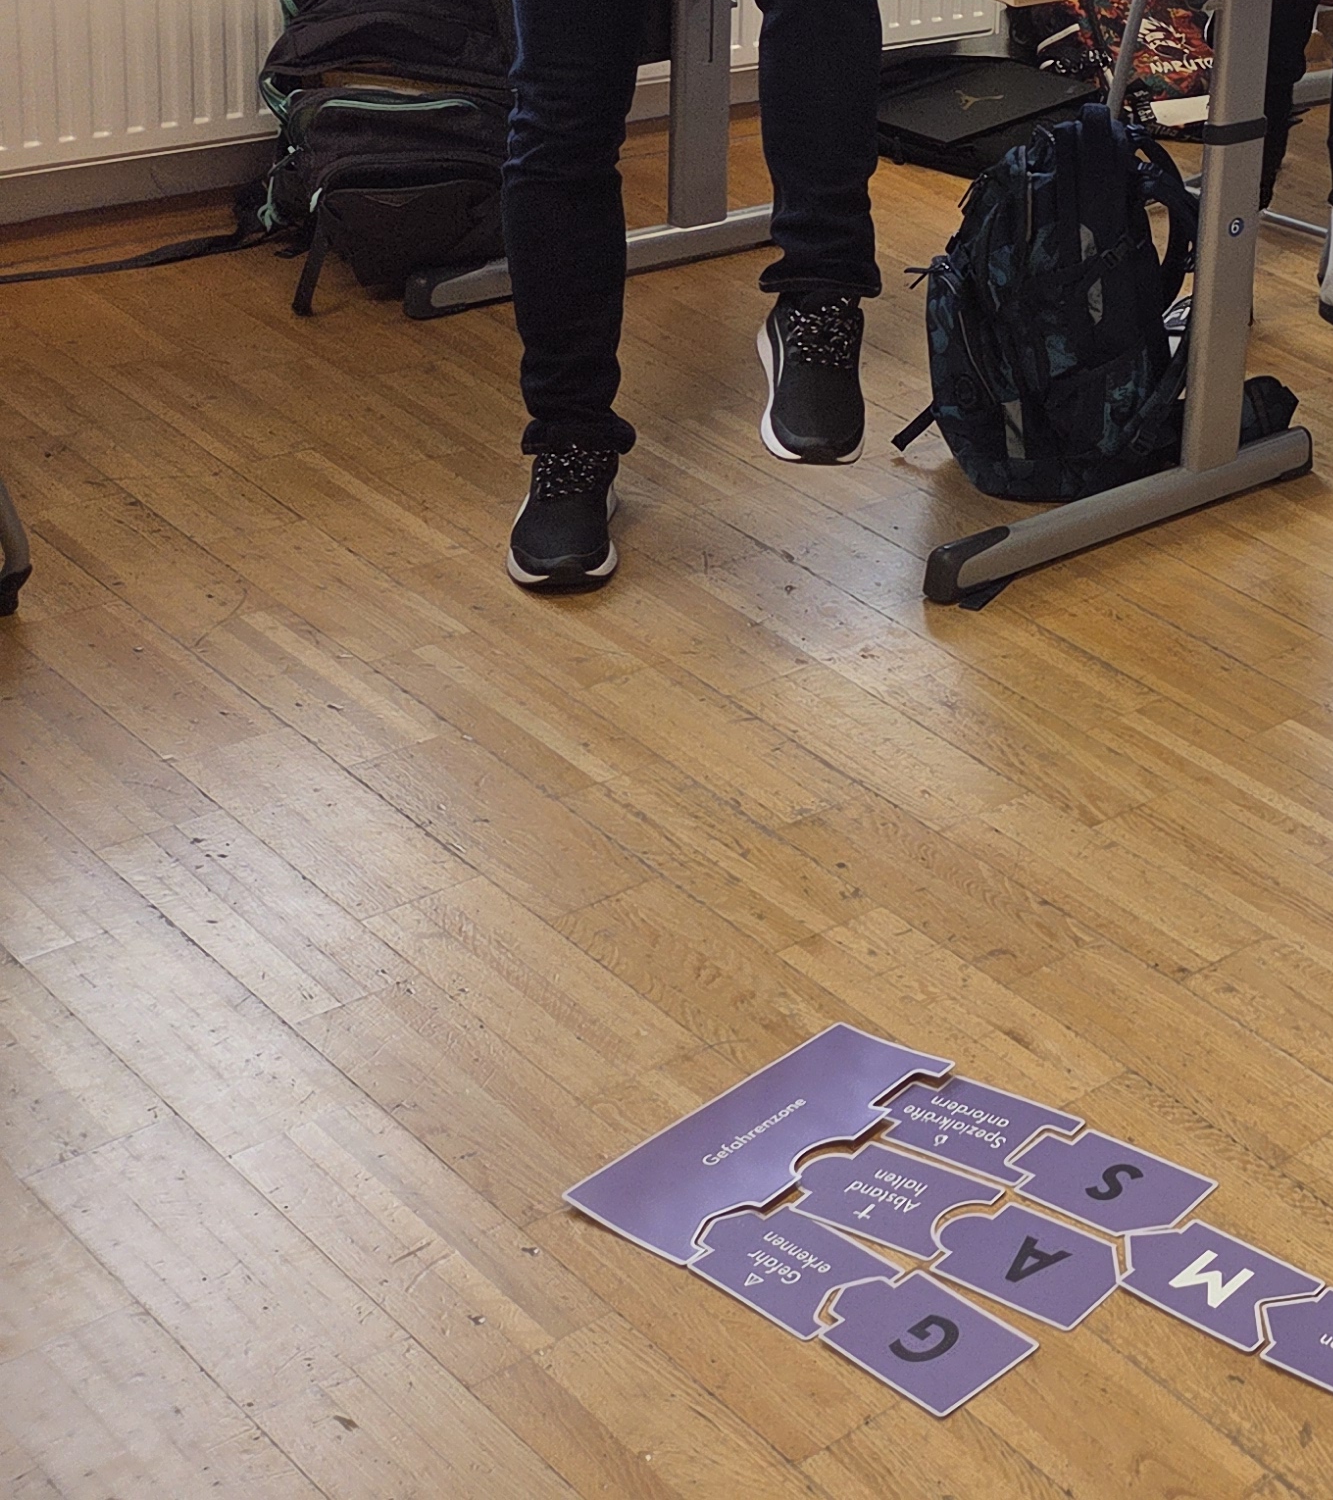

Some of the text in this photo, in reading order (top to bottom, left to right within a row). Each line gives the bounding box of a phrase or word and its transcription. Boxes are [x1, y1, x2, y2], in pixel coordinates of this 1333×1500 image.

[1150, 55, 1214, 75] NARUTO
[1231, 219, 1240, 234] 6
[1164, 307, 1190, 323] FI
[903, 1104, 1007, 1150] Spezialkräfte
[931, 1095, 1011, 1129] anfordern
[702, 1097, 807, 1167] Gefahrenzone
[844, 1179, 922, 1214] Abstand
[874, 1168, 928, 1197] halten
[1085, 1163, 1145, 1201] S
[747, 1249, 802, 1286] Gefahr
[763, 1230, 832, 1275] erkennen
[1005, 1235, 1073, 1283] A
[1168, 1249, 1255, 1309] M
[888, 1314, 960, 1363] G
